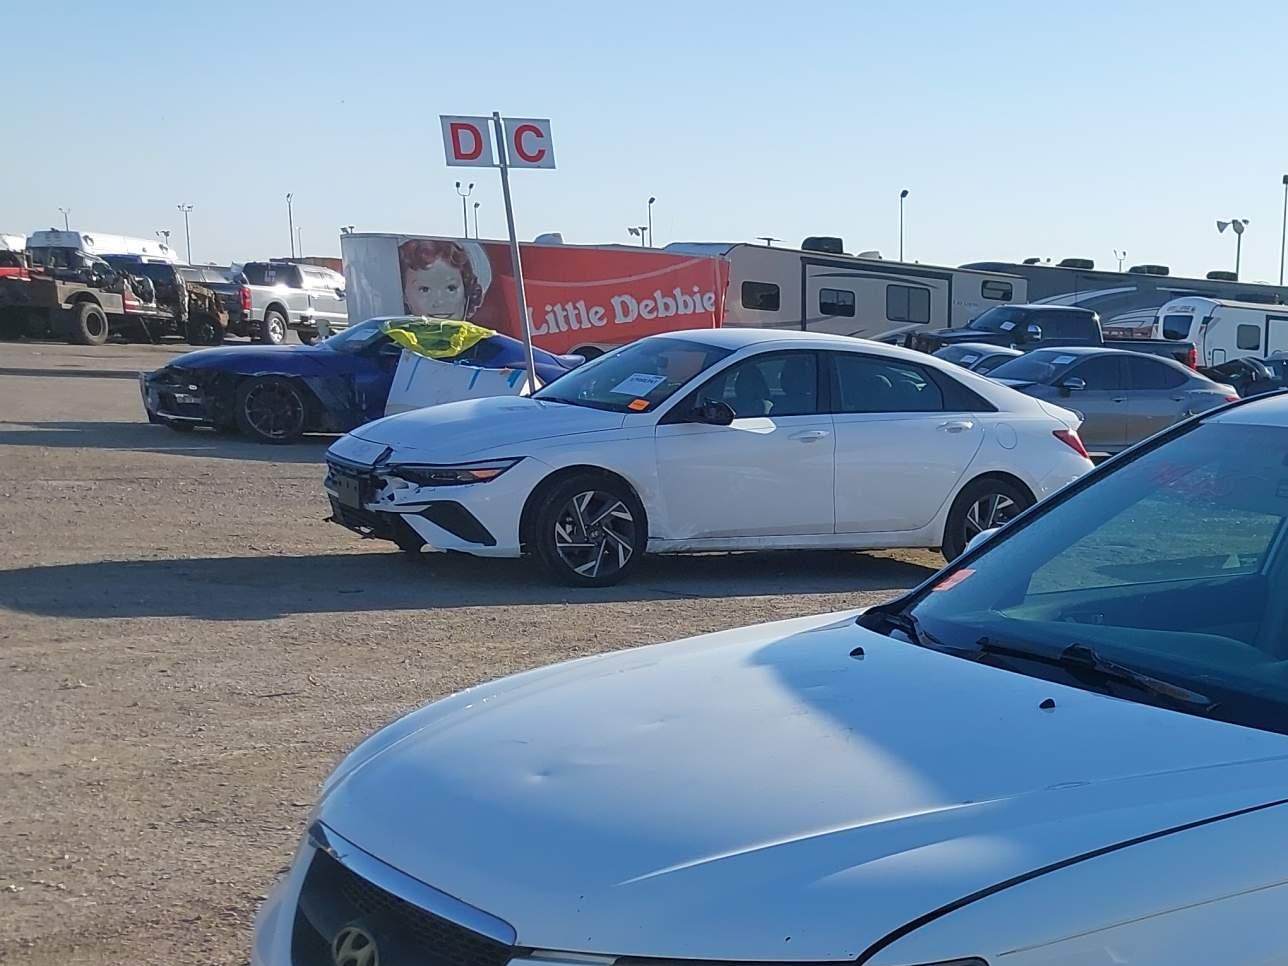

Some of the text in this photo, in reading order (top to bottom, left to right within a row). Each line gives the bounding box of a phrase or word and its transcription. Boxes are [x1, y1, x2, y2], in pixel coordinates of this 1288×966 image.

[449, 122, 483, 161] D
[513, 124, 545, 163] C
[528, 285, 716, 337] Little Debbie
